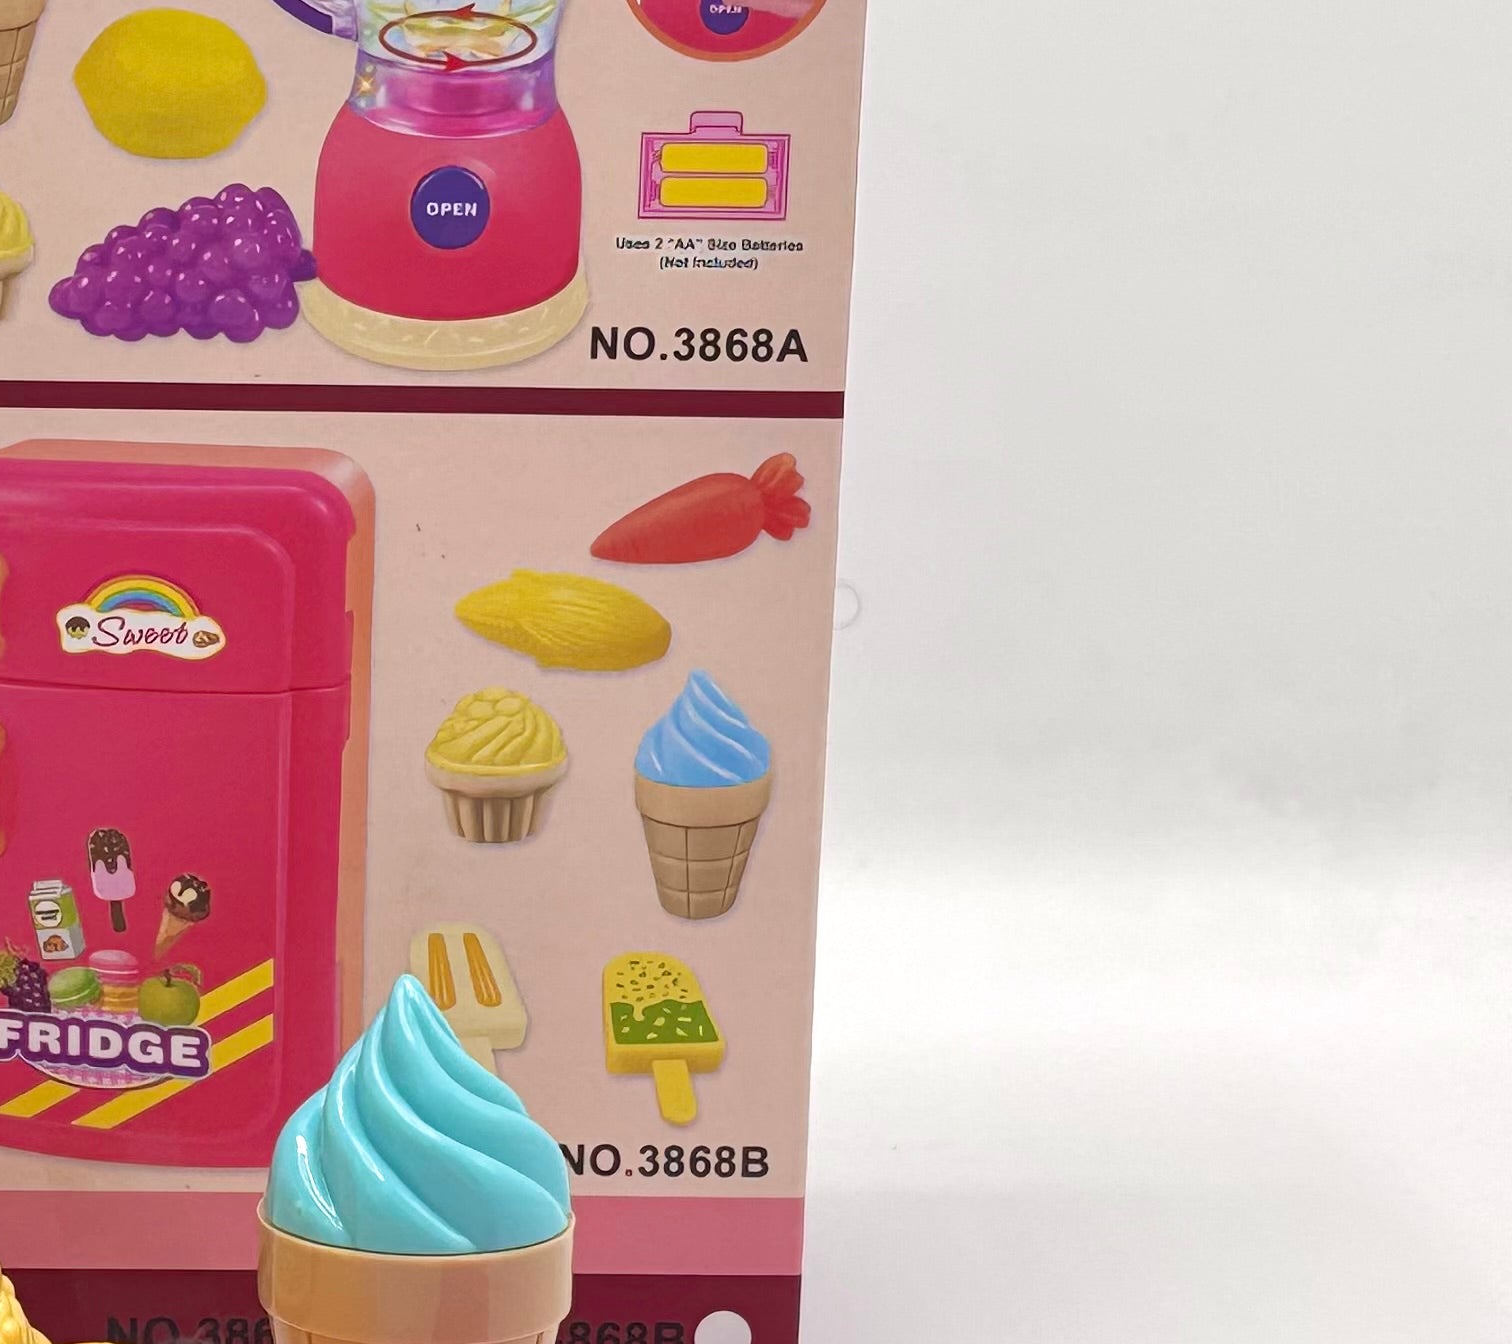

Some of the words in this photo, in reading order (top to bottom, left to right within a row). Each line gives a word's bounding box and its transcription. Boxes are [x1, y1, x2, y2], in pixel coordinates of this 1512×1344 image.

[426, 202, 477, 218] OPEN
[655, 238, 664, 250] 2
[590, 325, 809, 364] NO.3868A
[91, 616, 189, 647] Sweet
[559, 1143, 769, 1178] NO.3868B
